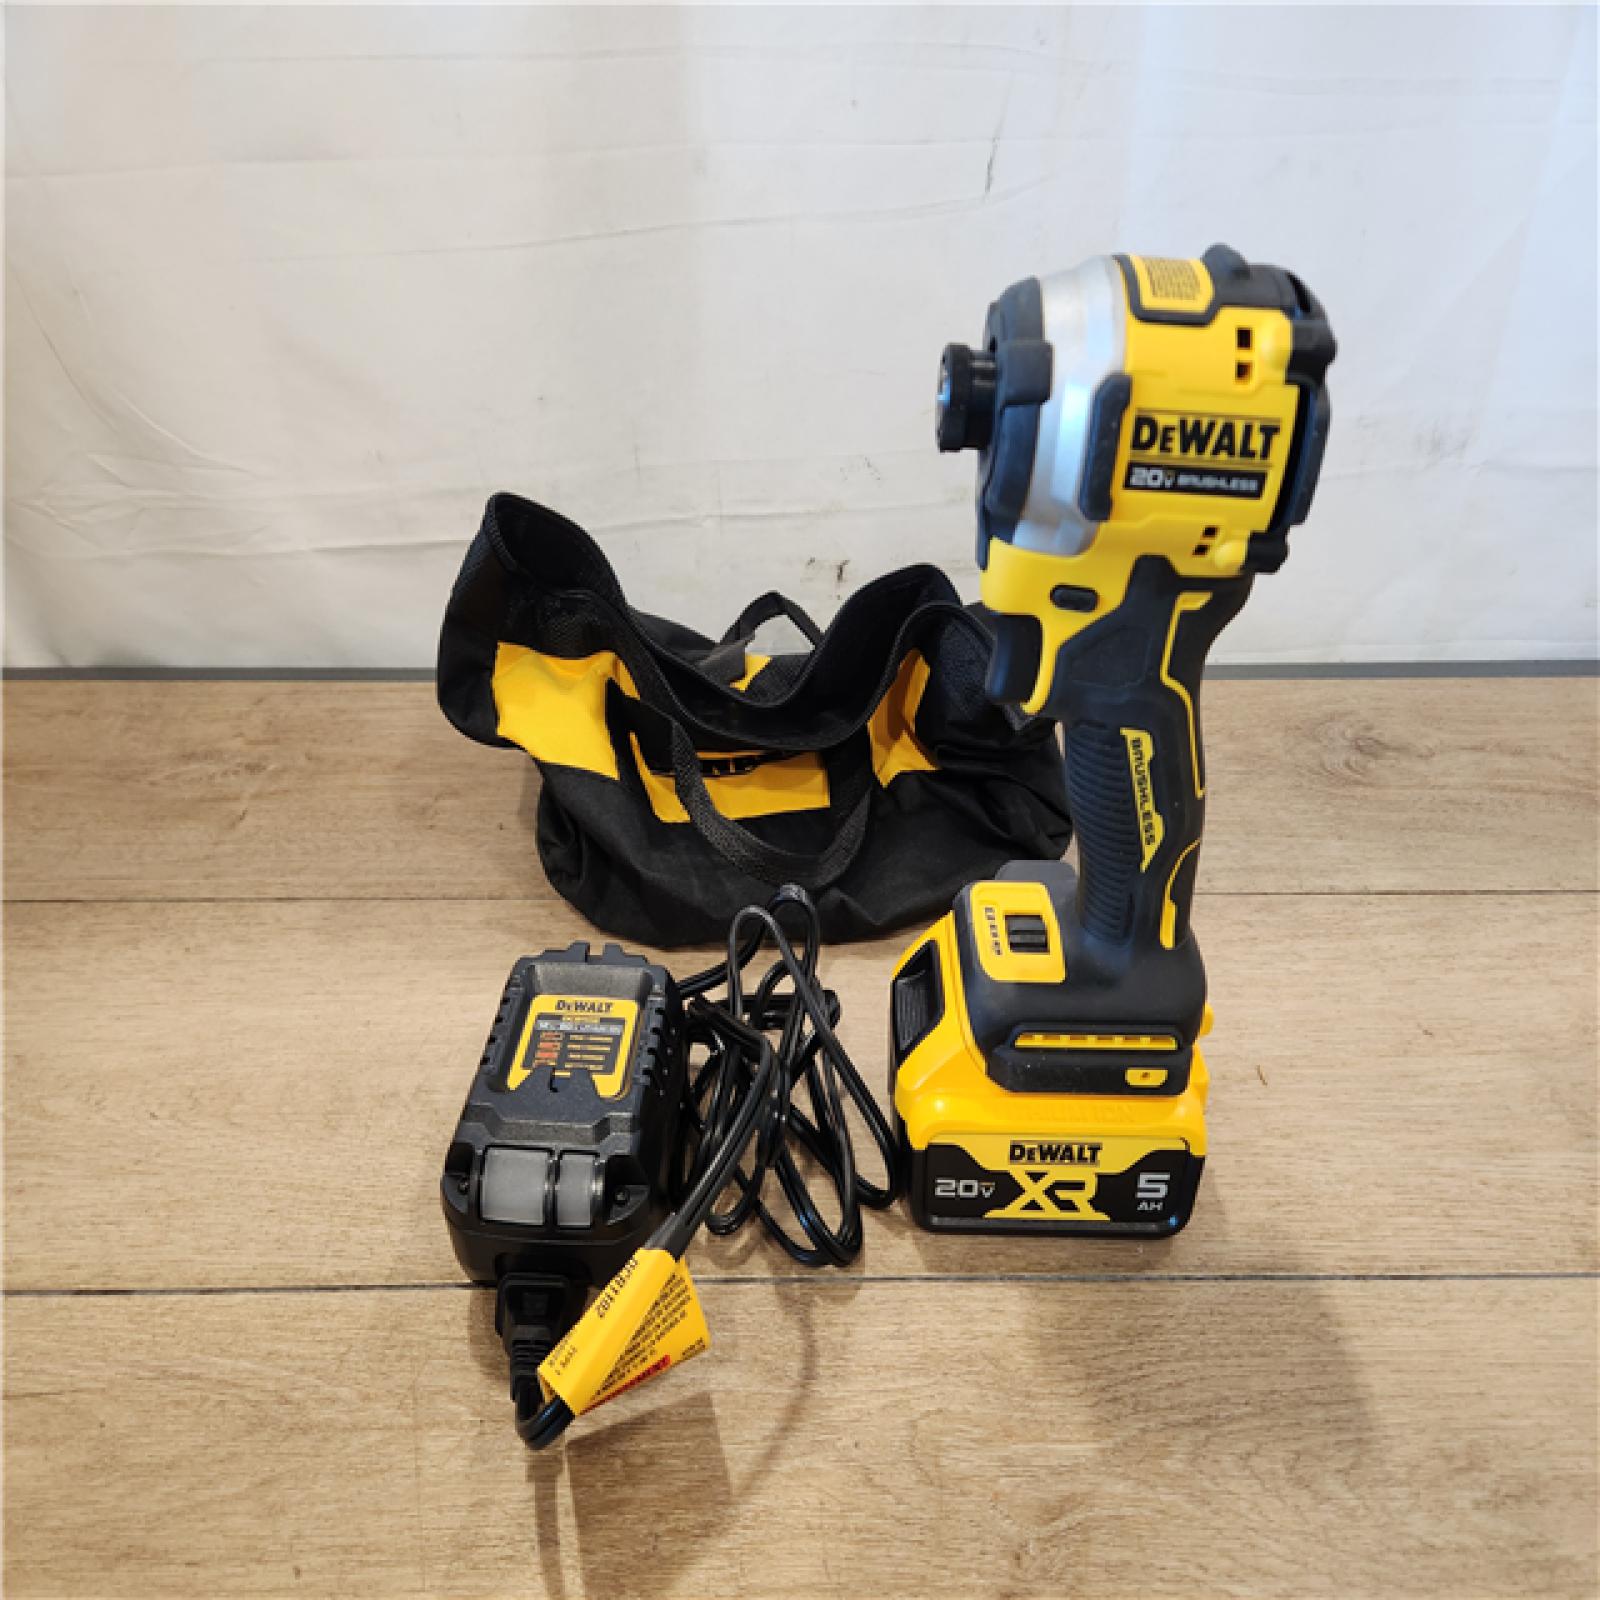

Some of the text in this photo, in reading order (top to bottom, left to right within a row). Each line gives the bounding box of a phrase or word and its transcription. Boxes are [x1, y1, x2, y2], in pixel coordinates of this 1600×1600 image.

[1132, 738, 1155, 845] BRUSHLESS
[988, 1171, 1109, 1221] XR
[1136, 1172, 1170, 1199] 5
